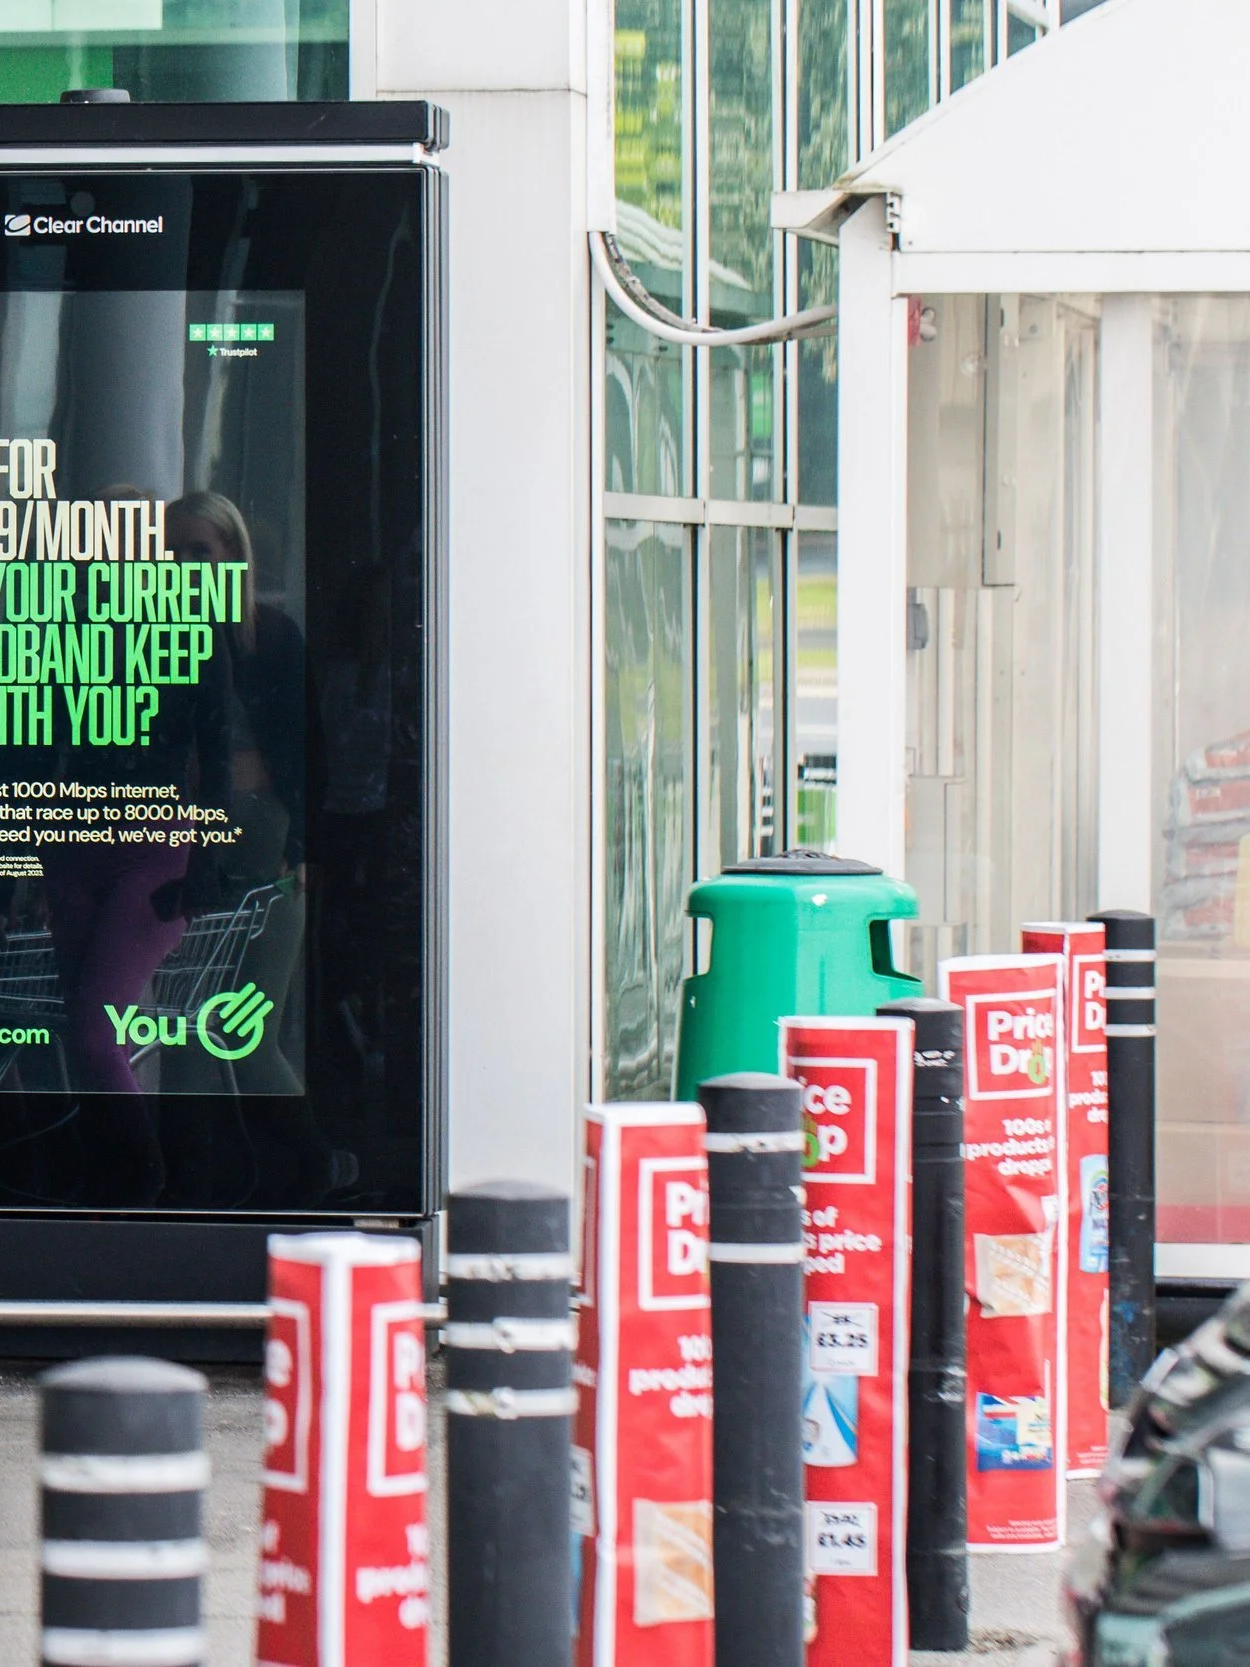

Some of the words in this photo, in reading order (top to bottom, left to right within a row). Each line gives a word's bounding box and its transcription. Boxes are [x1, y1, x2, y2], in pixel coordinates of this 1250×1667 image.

[33, 216, 84, 234] Clear
[86, 216, 163, 234] Channel
[219, 347, 258, 358] Trustpilot
[88, 562, 248, 622] CURRENT
[126, 624, 213, 684] KEEP
[64, 685, 159, 745] YOU?
[12, 782, 56, 798] 1000
[59, 782, 107, 802] Mbps
[111, 782, 180, 801] internet,
[36, 806, 74, 820] race
[77, 808, 100, 824] up
[102, 806, 121, 821] to
[124, 804, 174, 821] 8000
[177, 804, 229, 825] Mbps,
[33, 829, 66, 847] you
[69, 826, 115, 844] need,
[169, 828, 197, 847] got
[104, 1005, 187, 1045] You
[819, 1230, 883, 1254] price
